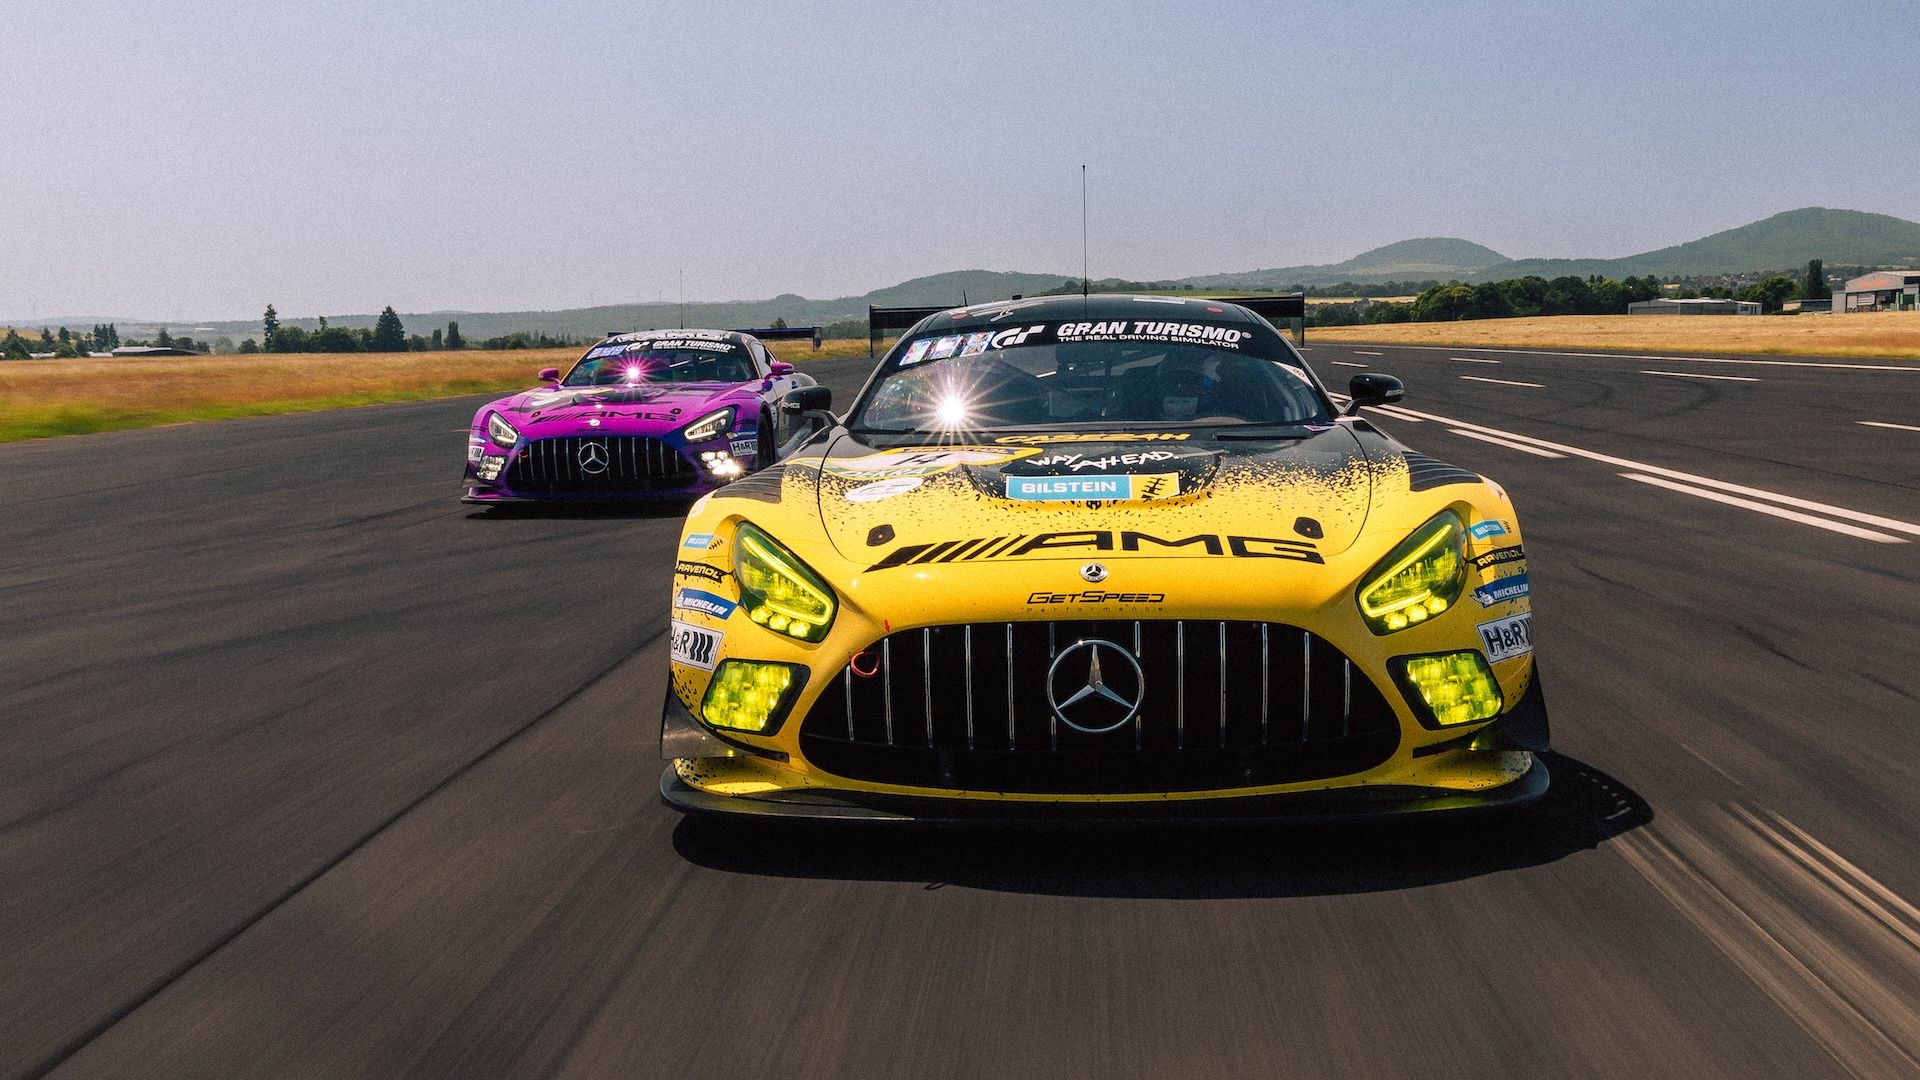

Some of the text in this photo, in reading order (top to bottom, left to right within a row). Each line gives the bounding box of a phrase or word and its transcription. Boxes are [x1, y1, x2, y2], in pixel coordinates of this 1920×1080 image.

[1056, 321, 1241, 343] GRAN TURISMO
[652, 339, 683, 347] GRAN
[1119, 334, 1168, 342] DRIVING
[1170, 336, 1240, 349] SIMULATOR
[573, 411, 678, 422] AMG
[731, 441, 752, 453] H&R
[1025, 453, 1083, 466] WAY
[1021, 481, 1118, 494] BILSTEIN
[1008, 530, 1326, 566] AMG
[1476, 549, 1523, 566] RAVENOL
[677, 563, 720, 579] RAVENOL
[1493, 583, 1529, 599] MICHELIN
[682, 597, 728, 615] MICHELIN
[1483, 621, 1526, 656] H&R
